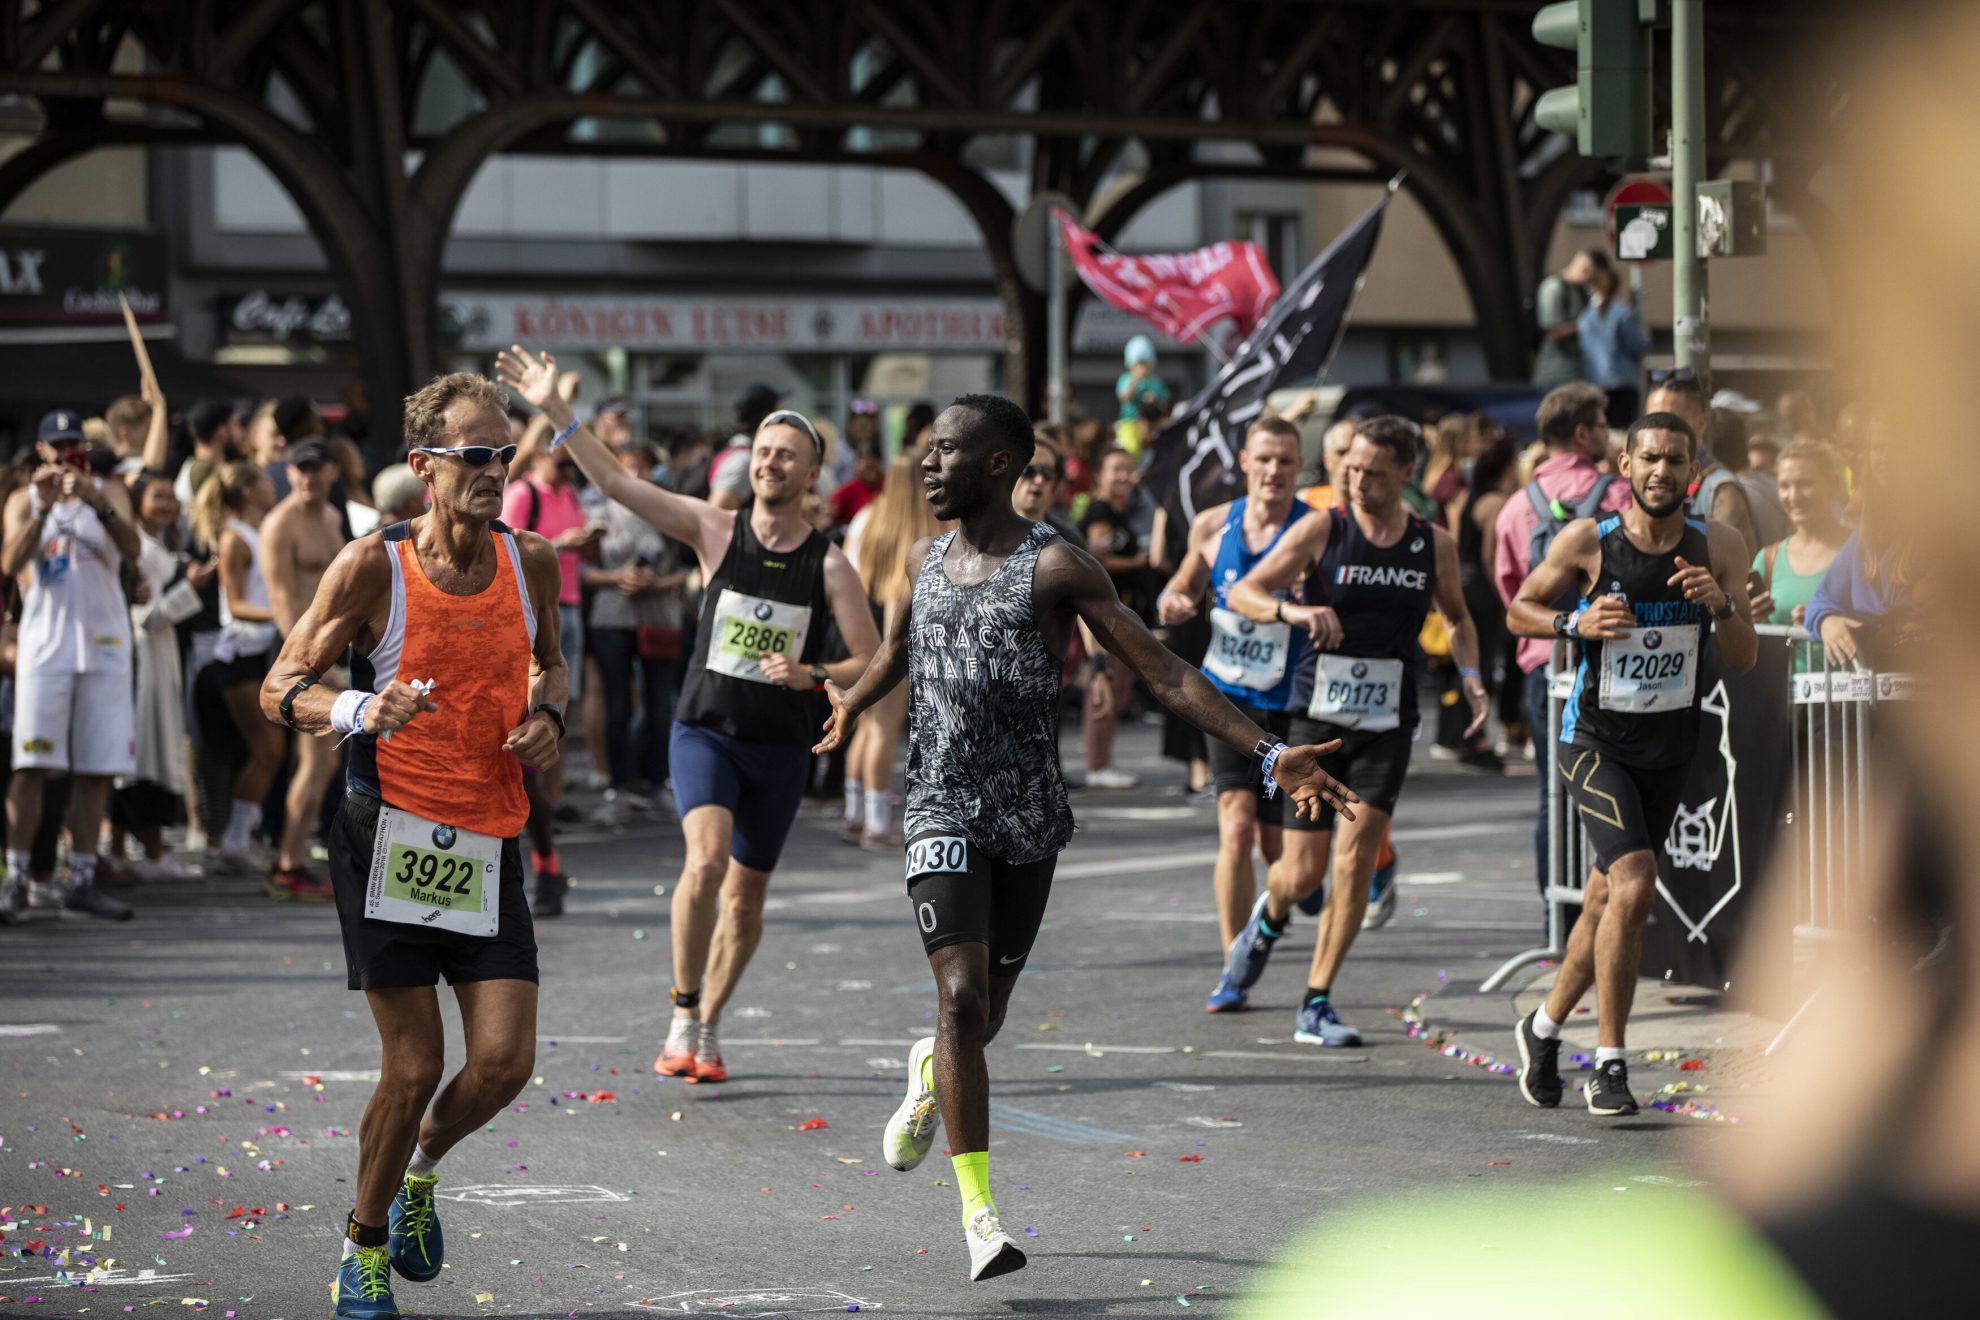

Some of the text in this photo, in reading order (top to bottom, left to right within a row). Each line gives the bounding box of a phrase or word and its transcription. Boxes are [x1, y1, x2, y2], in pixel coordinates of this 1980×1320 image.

[514, 296, 673, 338] KÖNIGIN
[1347, 565, 1427, 590] FRANCE
[730, 622, 788, 653] 2886
[916, 624, 1019, 652] TRACK
[923, 656, 1023, 682] MAFIA
[1616, 652, 1684, 680] 12029
[1328, 680, 1388, 706] 60173
[1638, 680, 1662, 691] Jason
[372, 818, 388, 884] BERLIN-MARATHON
[395, 850, 474, 895] 3922
[486, 863, 494, 873] C
[376, 870, 384, 900] September
[410, 887, 452, 907] Markus
[421, 909, 442, 924] here
